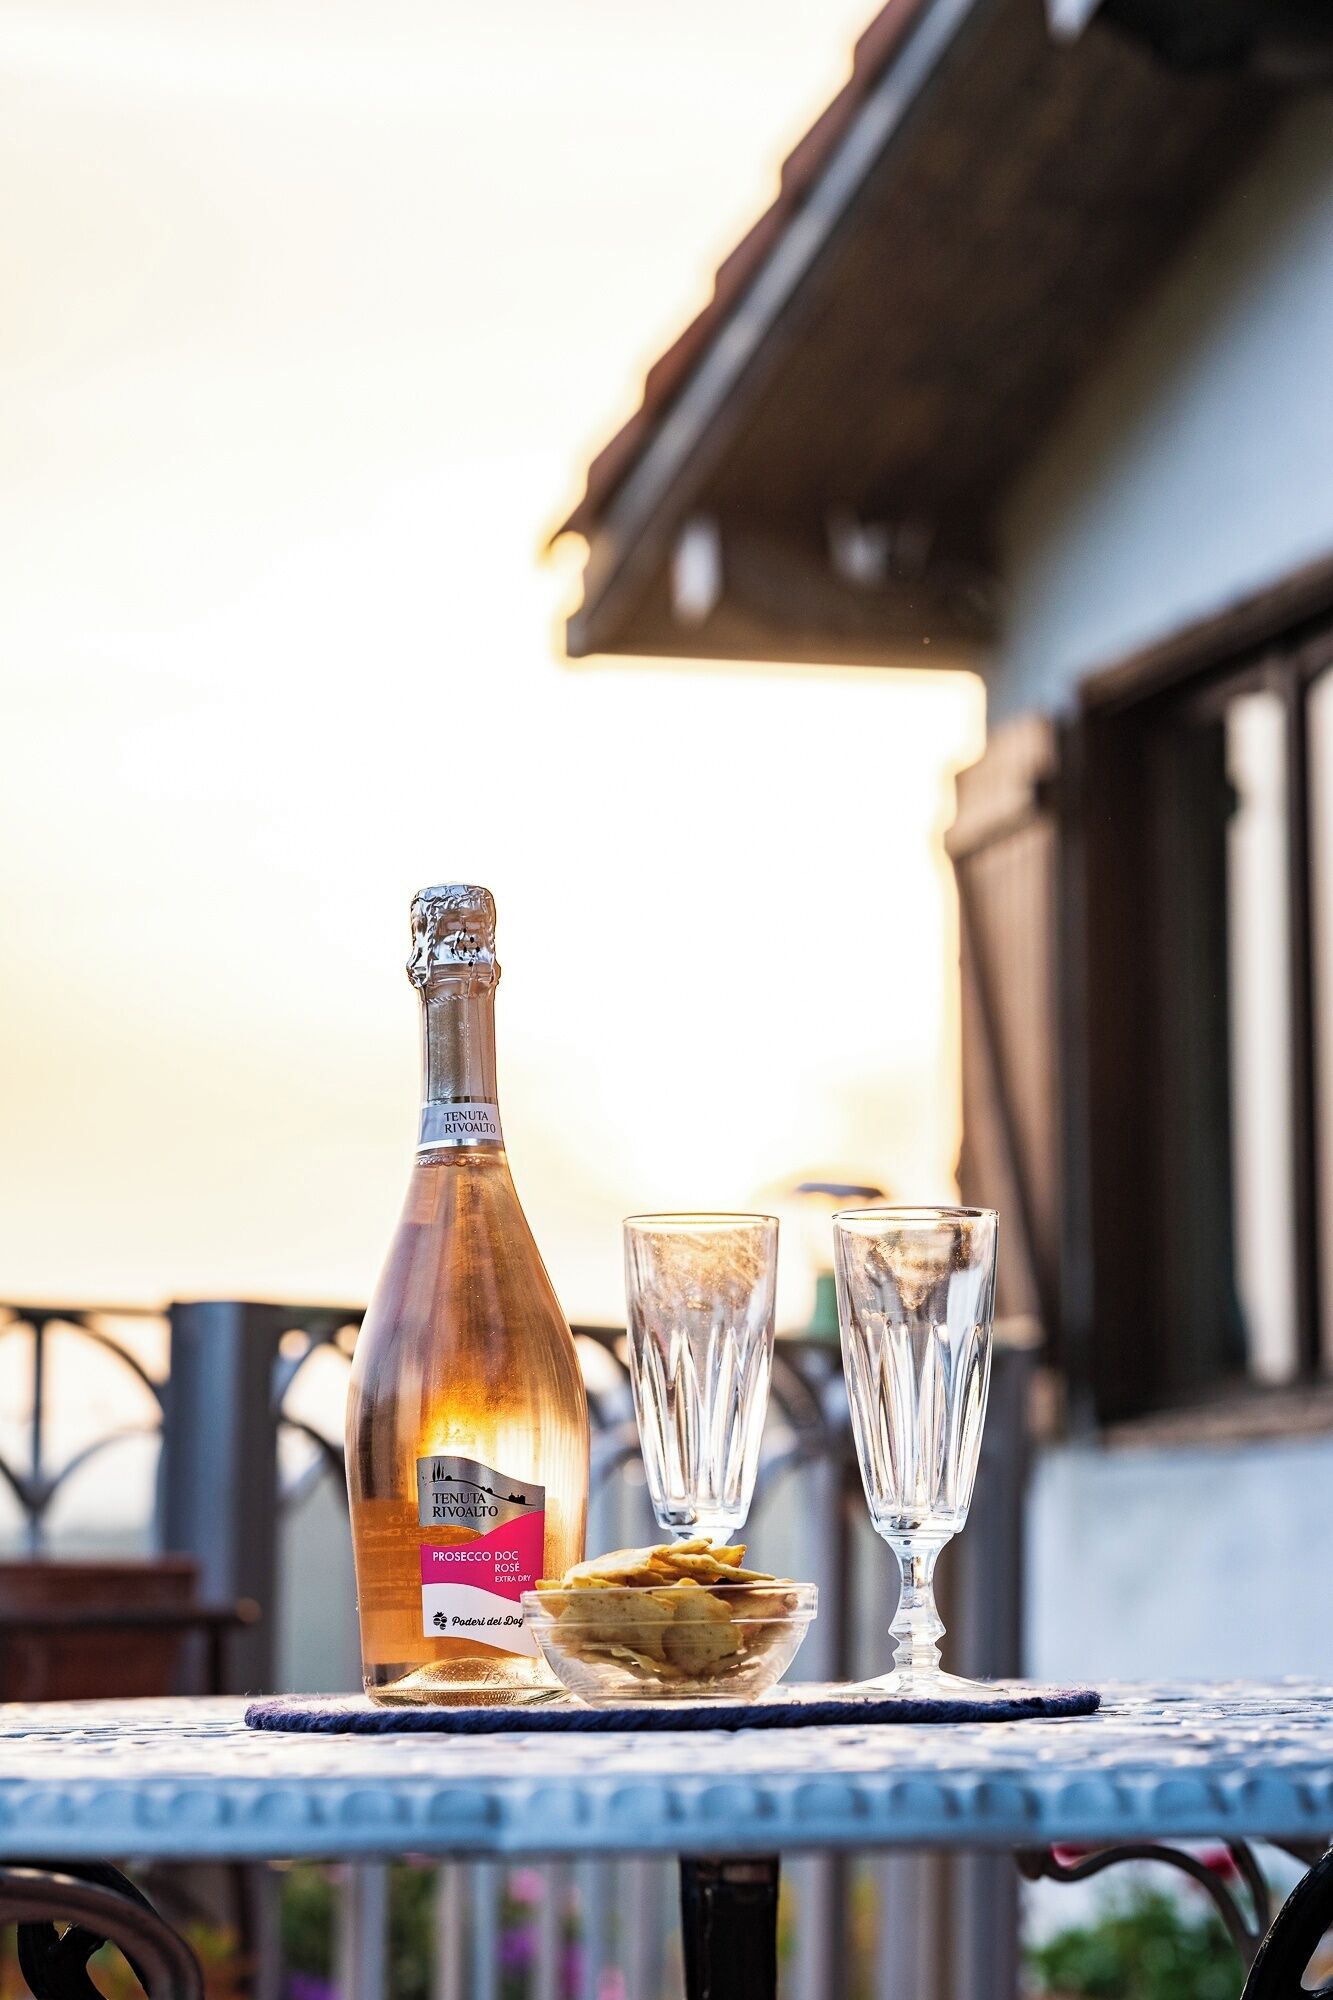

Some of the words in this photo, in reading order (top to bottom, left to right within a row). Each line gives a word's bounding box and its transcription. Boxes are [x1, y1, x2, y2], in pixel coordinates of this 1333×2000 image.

[444, 1110, 488, 1122] TENUTA
[445, 1122, 496, 1134] RIVOALTO
[432, 1493, 486, 1504] TENUTA
[432, 1506, 498, 1518] RIVOALTO
[432, 1552, 492, 1562] PROSECCO
[494, 1551, 518, 1560] DOC
[494, 1562, 520, 1572] ROSÉ
[452, 1616, 486, 1626] Poderi
[486, 1617, 502, 1626] del
[504, 1616, 523, 1628] Dog
